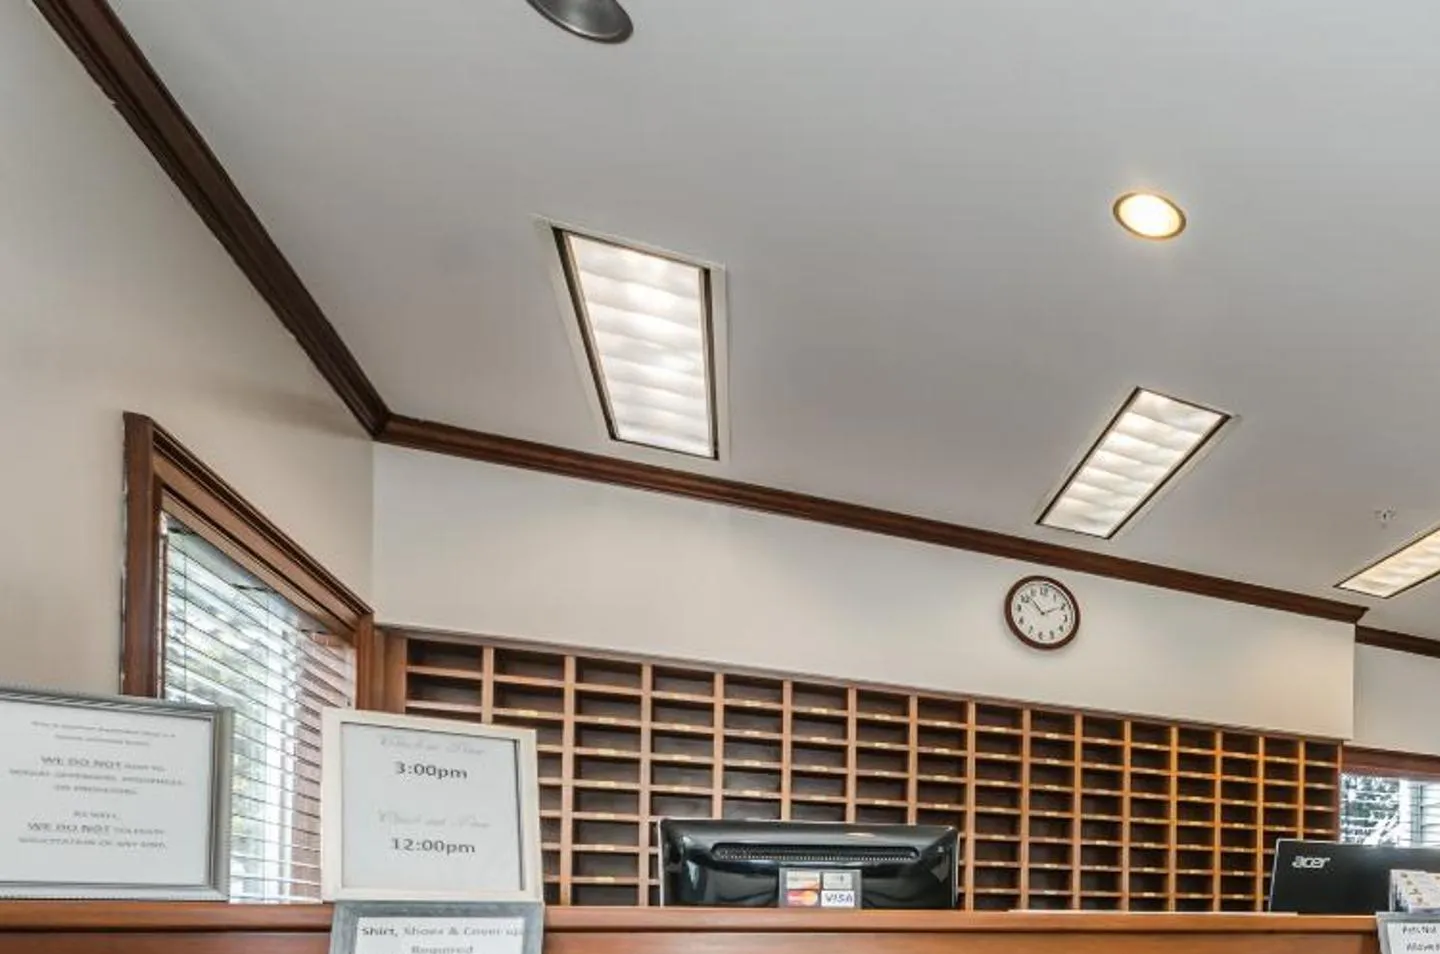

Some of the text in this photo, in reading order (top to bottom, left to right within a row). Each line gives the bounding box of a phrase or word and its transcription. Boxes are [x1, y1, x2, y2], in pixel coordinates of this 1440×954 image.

[394, 761, 468, 780] 3:00pm
[391, 837, 476, 856] 12:00pm
[1292, 855, 1331, 869] acer
[824, 892, 853, 902] VISA
[362, 926, 399, 938] Shirt,
